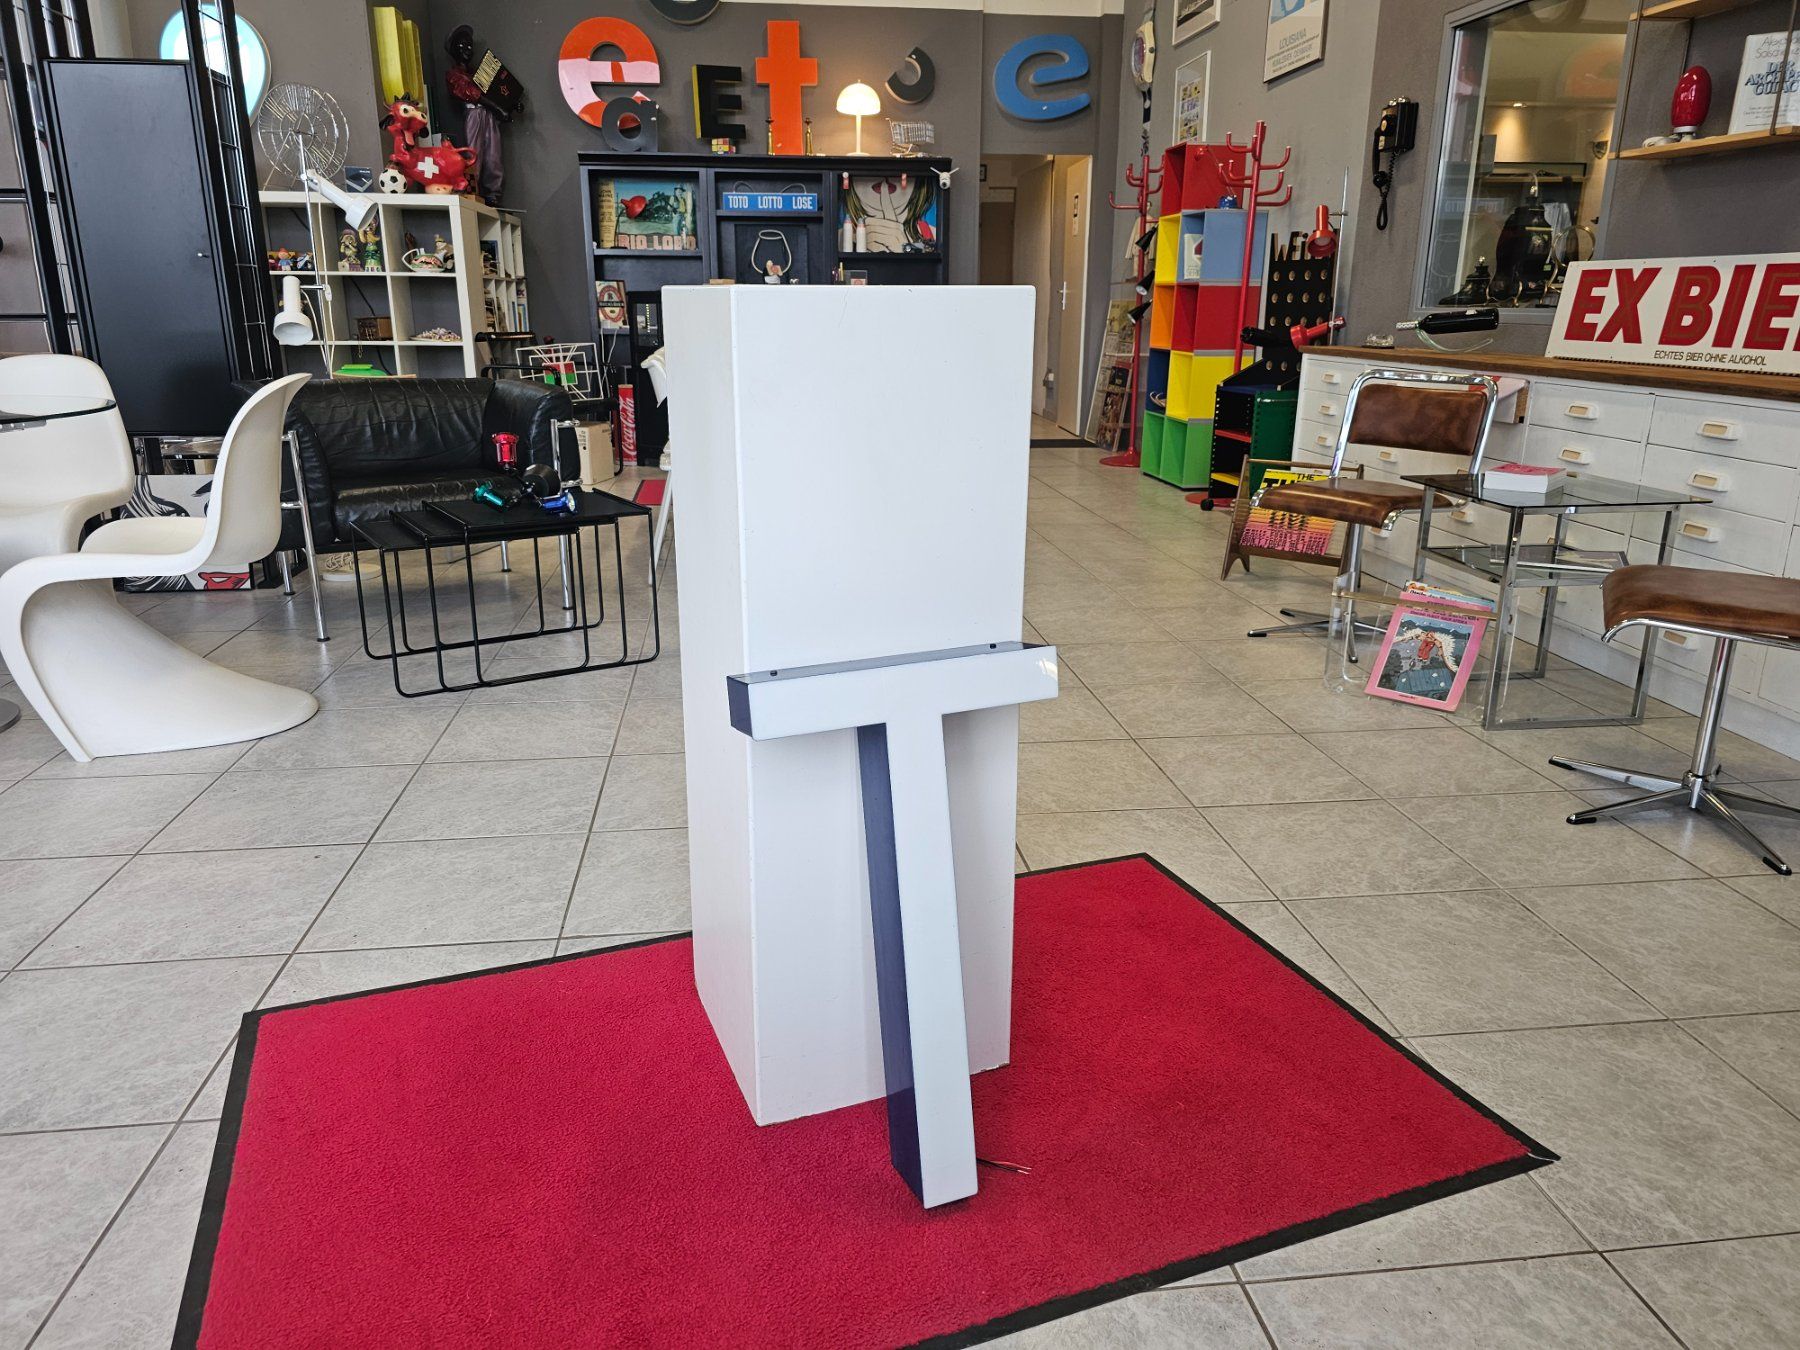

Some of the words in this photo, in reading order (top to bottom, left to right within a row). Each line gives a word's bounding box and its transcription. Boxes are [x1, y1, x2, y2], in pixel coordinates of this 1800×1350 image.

[692, 64, 746, 139] E
[728, 195, 749, 209] TOTO
[758, 196, 783, 209] LOTTO
[792, 196, 814, 209] LOSE
[618, 234, 647, 250] RIO
[653, 235, 696, 251] LOBO
[1564, 268, 1662, 344] EX
[1658, 264, 1800, 352] BIE
[1653, 350, 1685, 361] ECHTES
[1685, 352, 1704, 361] BIER
[1704, 353, 1728, 363] OHNE
[1728, 354, 1768, 366] ALKOHOL
[1297, 473, 1315, 481] THE
[727, 644, 1058, 1209] T
